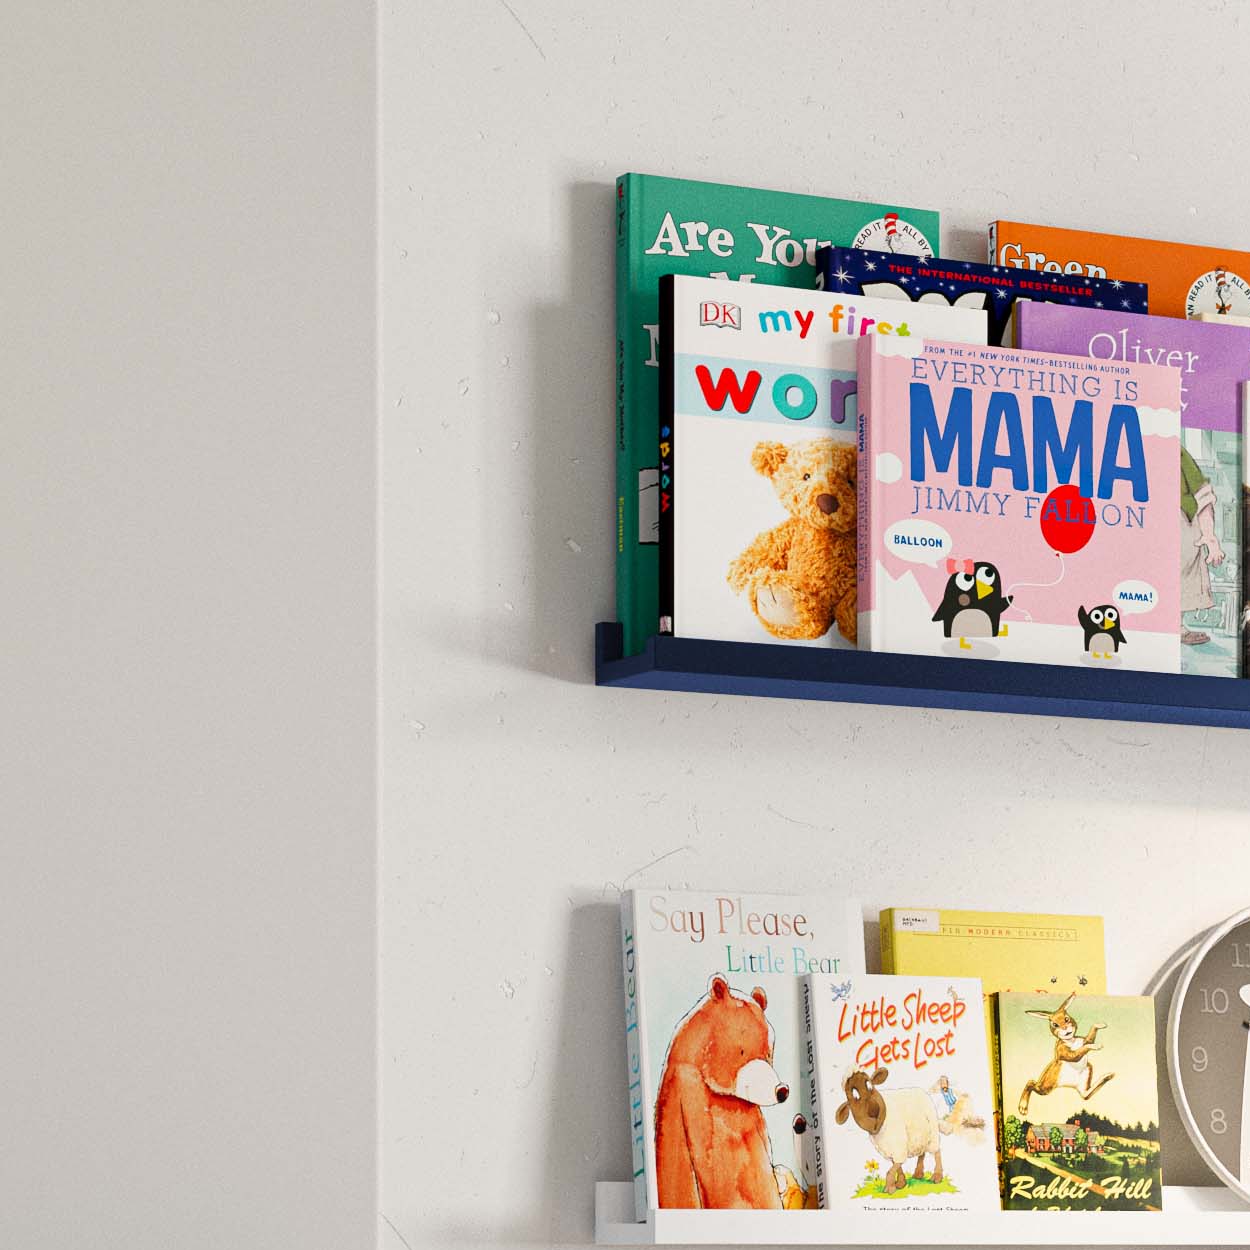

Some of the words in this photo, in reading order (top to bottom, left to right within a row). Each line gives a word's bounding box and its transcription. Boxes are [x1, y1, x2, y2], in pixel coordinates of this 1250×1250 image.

[645, 211, 735, 257] Are
[746, 222, 831, 266] You
[856, 228, 873, 248] READ
[902, 224, 917, 240] ALL
[889, 264, 914, 276] THE
[918, 267, 1015, 288] INTERNATIONAL
[1020, 279, 1093, 297] BESTSELLER
[1188, 281, 1204, 302] READ
[1205, 274, 1213, 283] IT
[1231, 276, 1244, 290] ALL
[703, 302, 738, 326] DK
[759, 309, 814, 339] my
[829, 304, 911, 337] first
[924, 345, 946, 355] FROM
[949, 347, 964, 357] THE
[967, 350, 977, 359] #1
[980, 352, 998, 361] NEW
[1001, 354, 1020, 364] YORK
[1100, 365, 1131, 376] AUTHOR
[1088, 328, 1199, 376] Oliver
[912, 357, 1101, 398] EVERYTHING
[1115, 379, 1138, 401] IS
[909, 382, 1150, 503] MAMA
[912, 485, 1012, 517] JIMMY
[1024, 496, 1147, 529] FALLON
[894, 534, 943, 548] BALLOON
[1118, 590, 1154, 603] MAMA!
[649, 895, 706, 943] Say
[716, 896, 815, 941] Please,
[968, 928, 1011, 937] MODERN
[726, 945, 785, 973] Little
[793, 947, 841, 974] Bear
[1199, 988, 1229, 1013] 10
[837, 995, 897, 1044] Little
[902, 988, 967, 1031] Sheep
[856, 1035, 911, 1070] Gets
[914, 1030, 956, 1069] Lost
[1191, 1047, 1208, 1072] 9
[1210, 1108, 1228, 1134] 8
[1009, 1174, 1094, 1200] Rabbit
[1099, 1175, 1153, 1200] Hill
